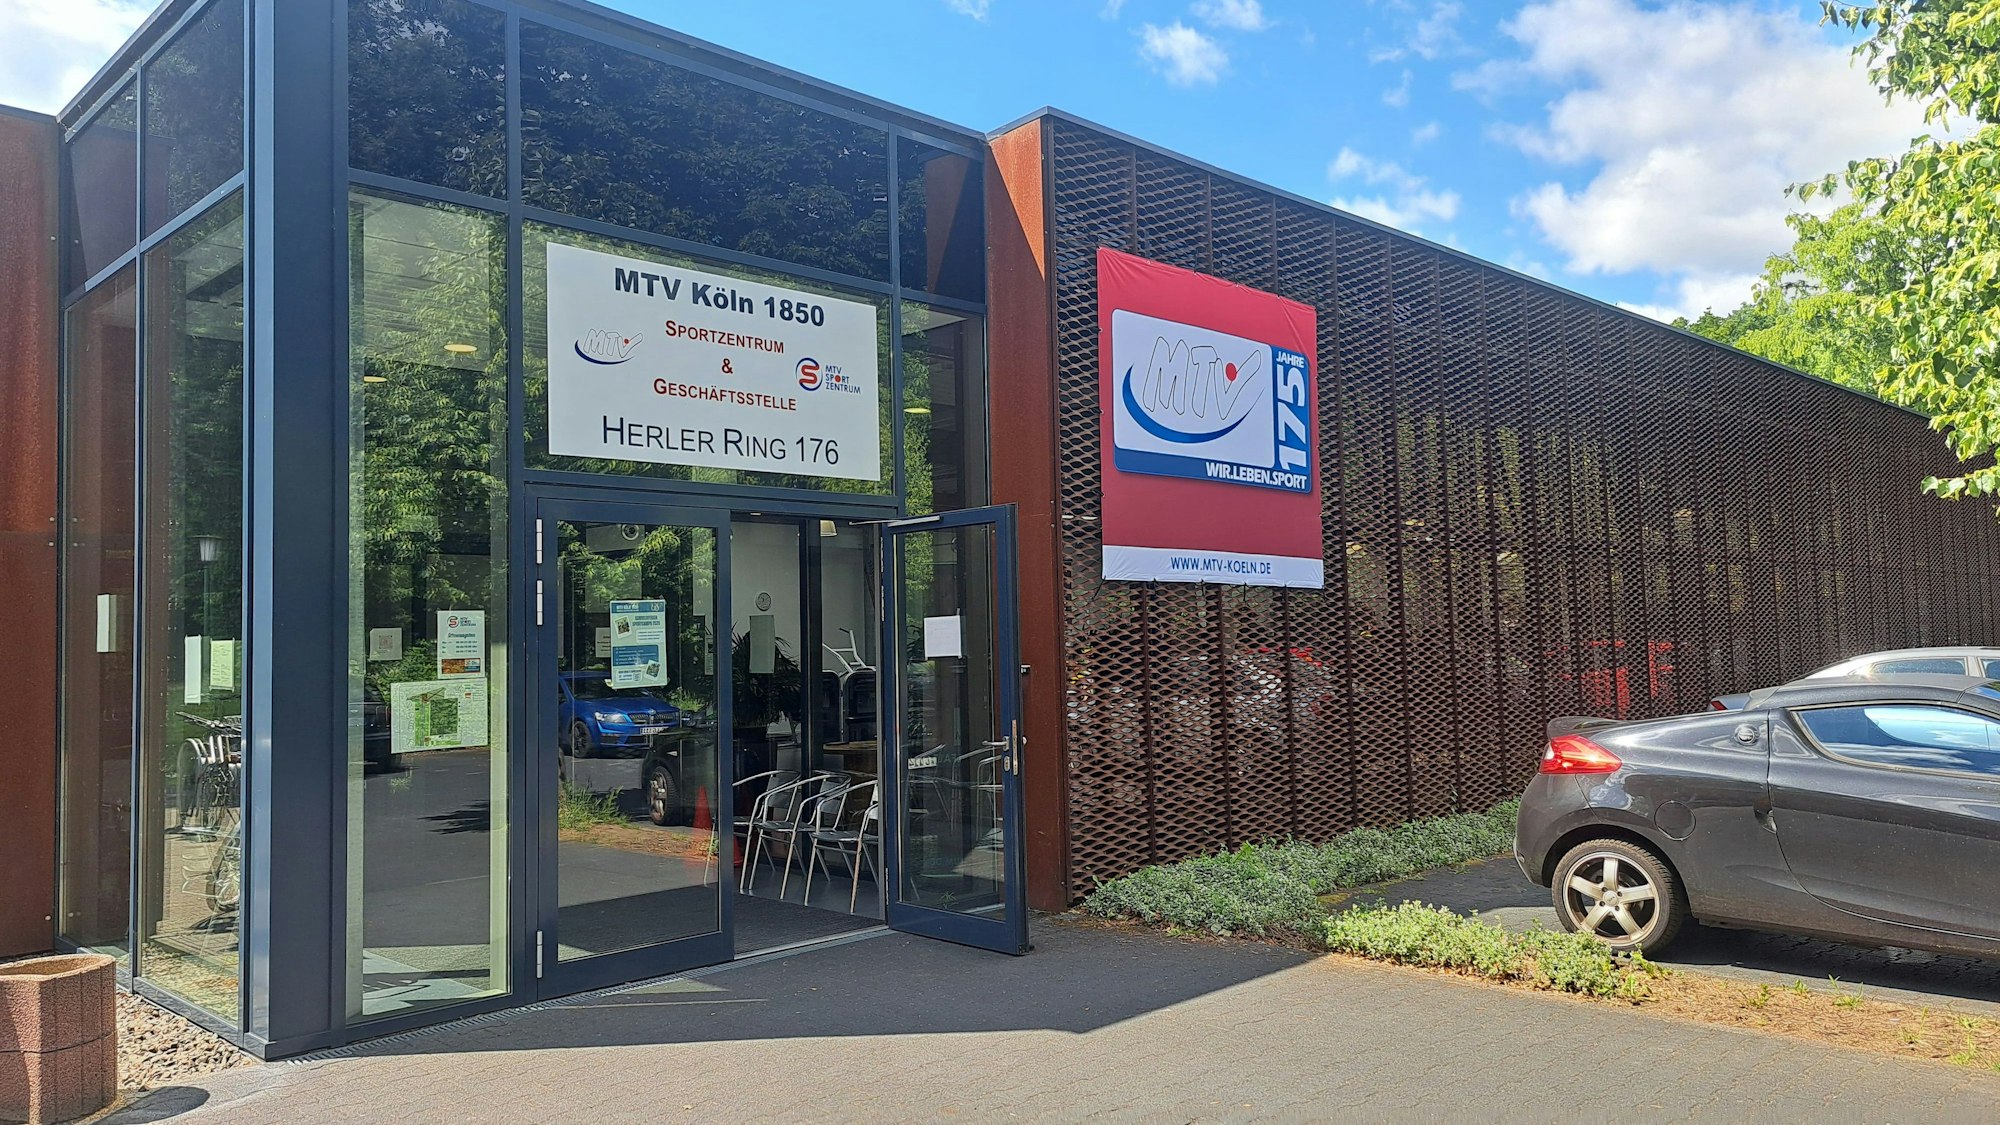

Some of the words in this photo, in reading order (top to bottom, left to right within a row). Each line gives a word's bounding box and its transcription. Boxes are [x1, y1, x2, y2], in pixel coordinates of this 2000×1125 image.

[615, 267, 681, 300] MTV
[692, 282, 753, 314] Köln
[764, 296, 825, 327] 1850
[583, 328, 643, 358] MTV
[665, 320, 784, 354] SPORTZENTRUM
[721, 358, 733, 374] &
[825, 365, 842, 374] MTV
[1276, 351, 1305, 368] JAHRE
[825, 382, 861, 394] ZENTRUM
[1142, 335, 1261, 420] MTV
[653, 378, 797, 411] GESCHÄFTSSTELLE
[1277, 364, 1307, 471] 175
[602, 415, 714, 454] HERLER
[724, 428, 787, 460] RING
[795, 436, 839, 465] 176
[1205, 461, 1307, 490] WIR.LEBEN.SPORT
[1170, 556, 1272, 575] WWW.MTV-KOELN.DE
